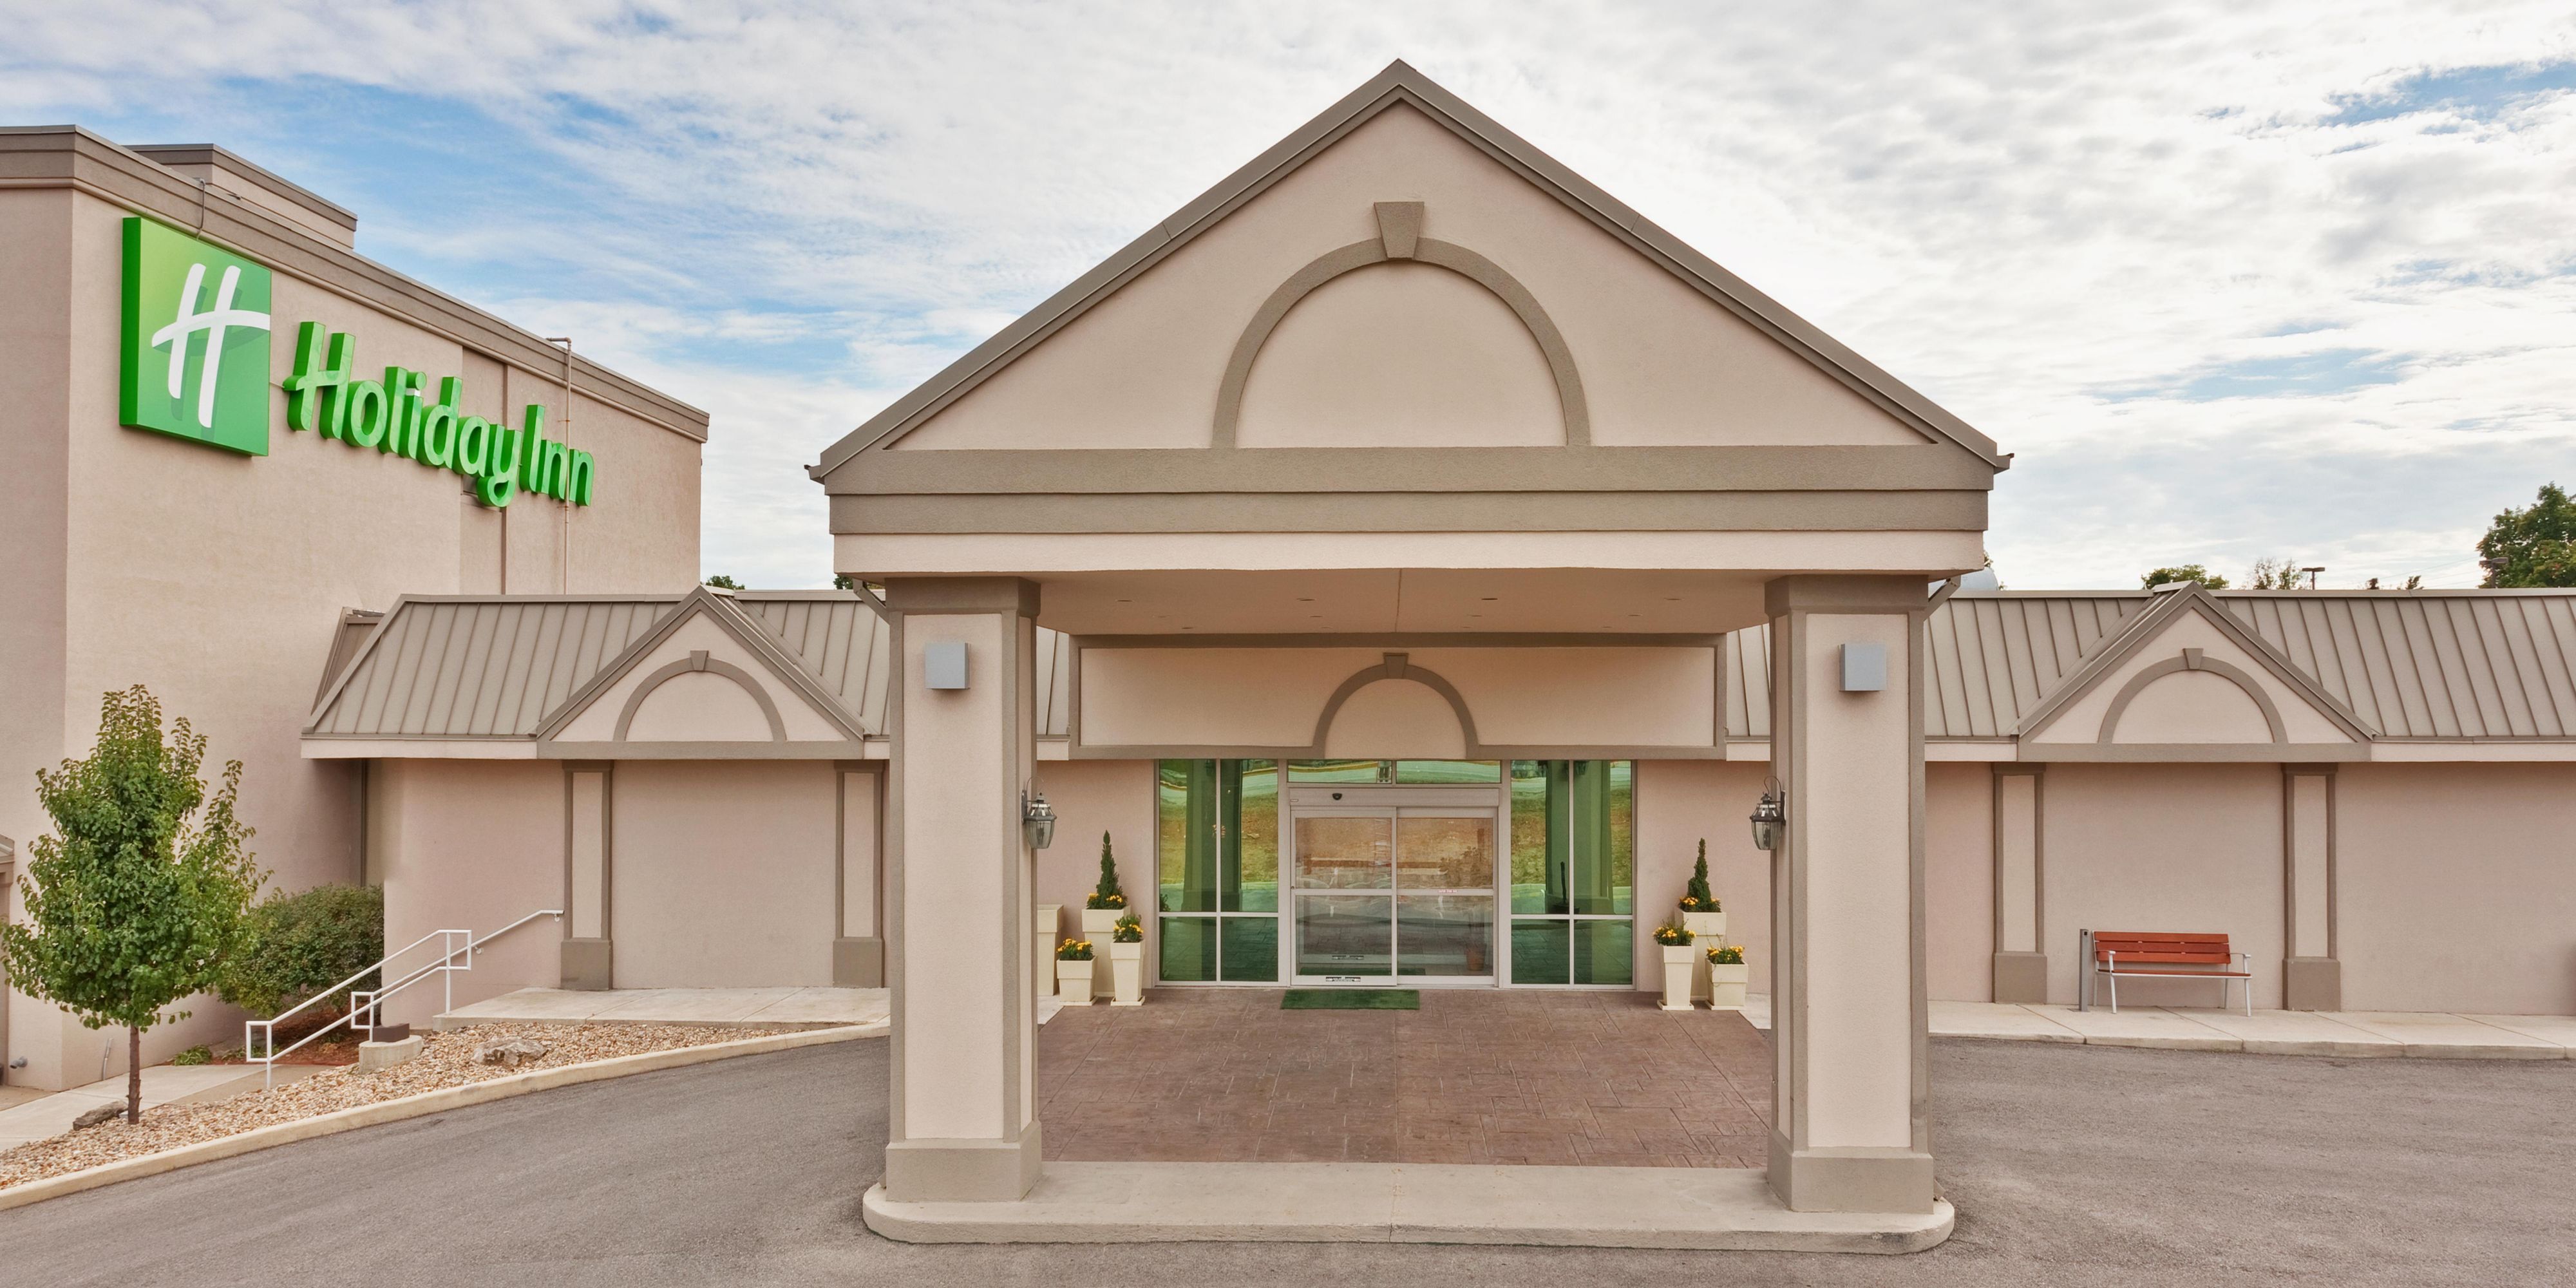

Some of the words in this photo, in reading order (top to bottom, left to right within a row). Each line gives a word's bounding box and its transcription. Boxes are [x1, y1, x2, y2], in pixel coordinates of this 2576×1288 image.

[152, 263, 270, 428] H
[283, 321, 522, 507] Holiday
[519, 404, 594, 507] Inn
